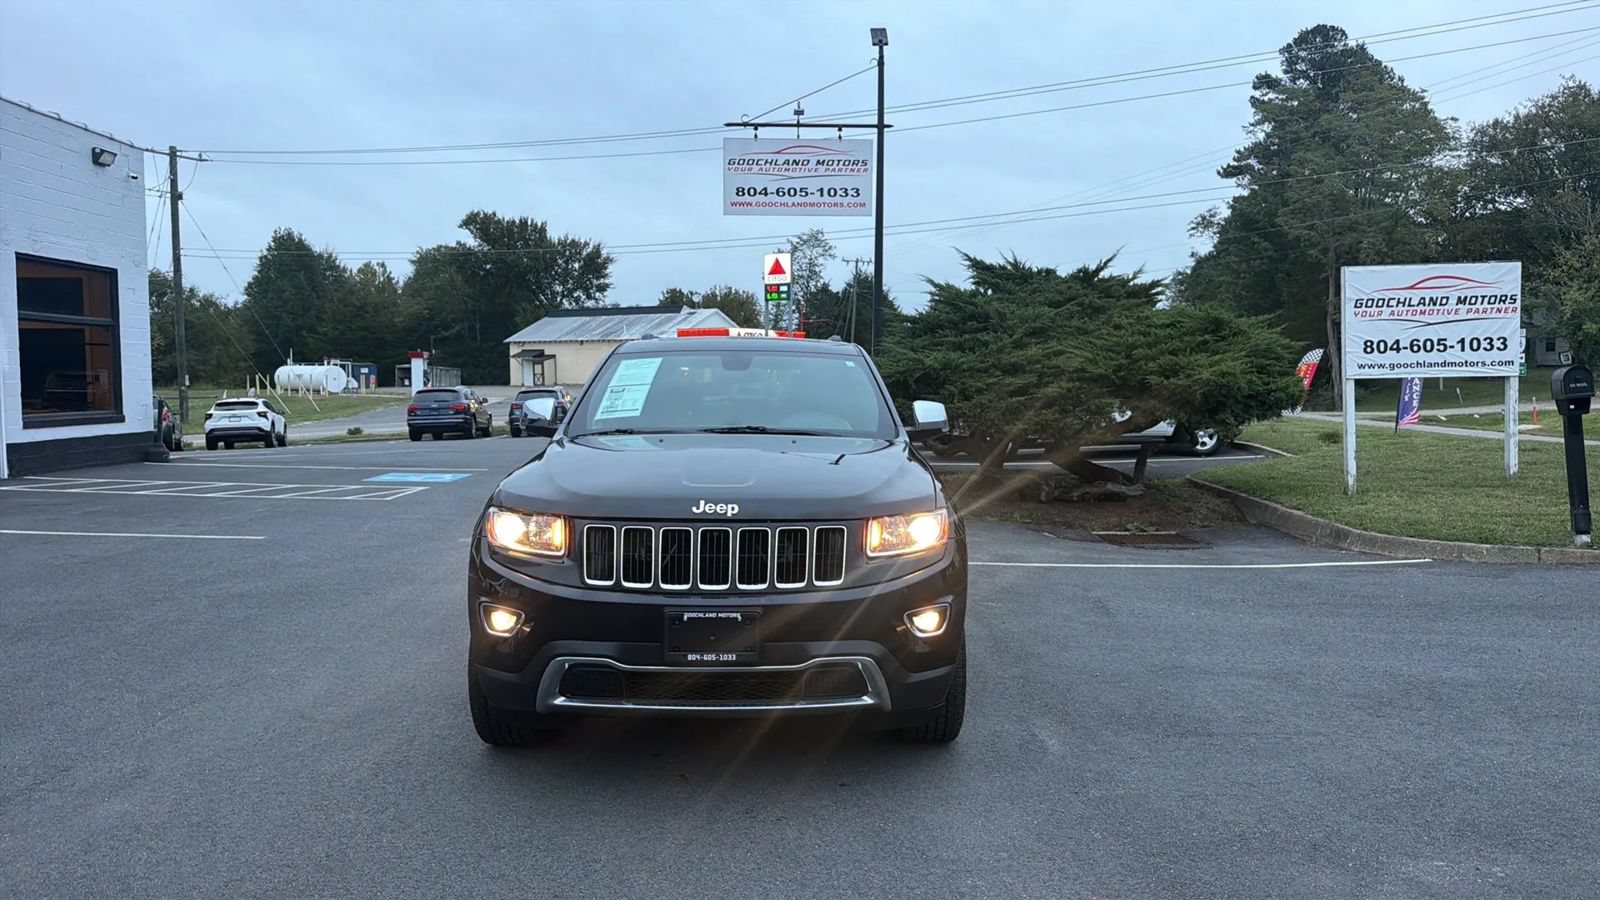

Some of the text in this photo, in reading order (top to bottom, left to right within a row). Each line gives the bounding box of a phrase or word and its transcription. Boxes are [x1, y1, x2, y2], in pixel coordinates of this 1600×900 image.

[727, 158, 869, 167] GOOCHLAND MOTORS
[735, 187, 861, 198] 804-605-1033
[730, 201, 866, 209] WWW.GOOCHLANDMOTORS.COM
[1353, 294, 1518, 309] GOOCHLAND MOTORS
[1353, 306, 1518, 318] YOUR AUTOMOTIVE PARTNER
[1363, 336, 1509, 355] 804-605-1033
[1357, 360, 1515, 371] www.goochlandmotors.com
[692, 500, 740, 517] Jeep
